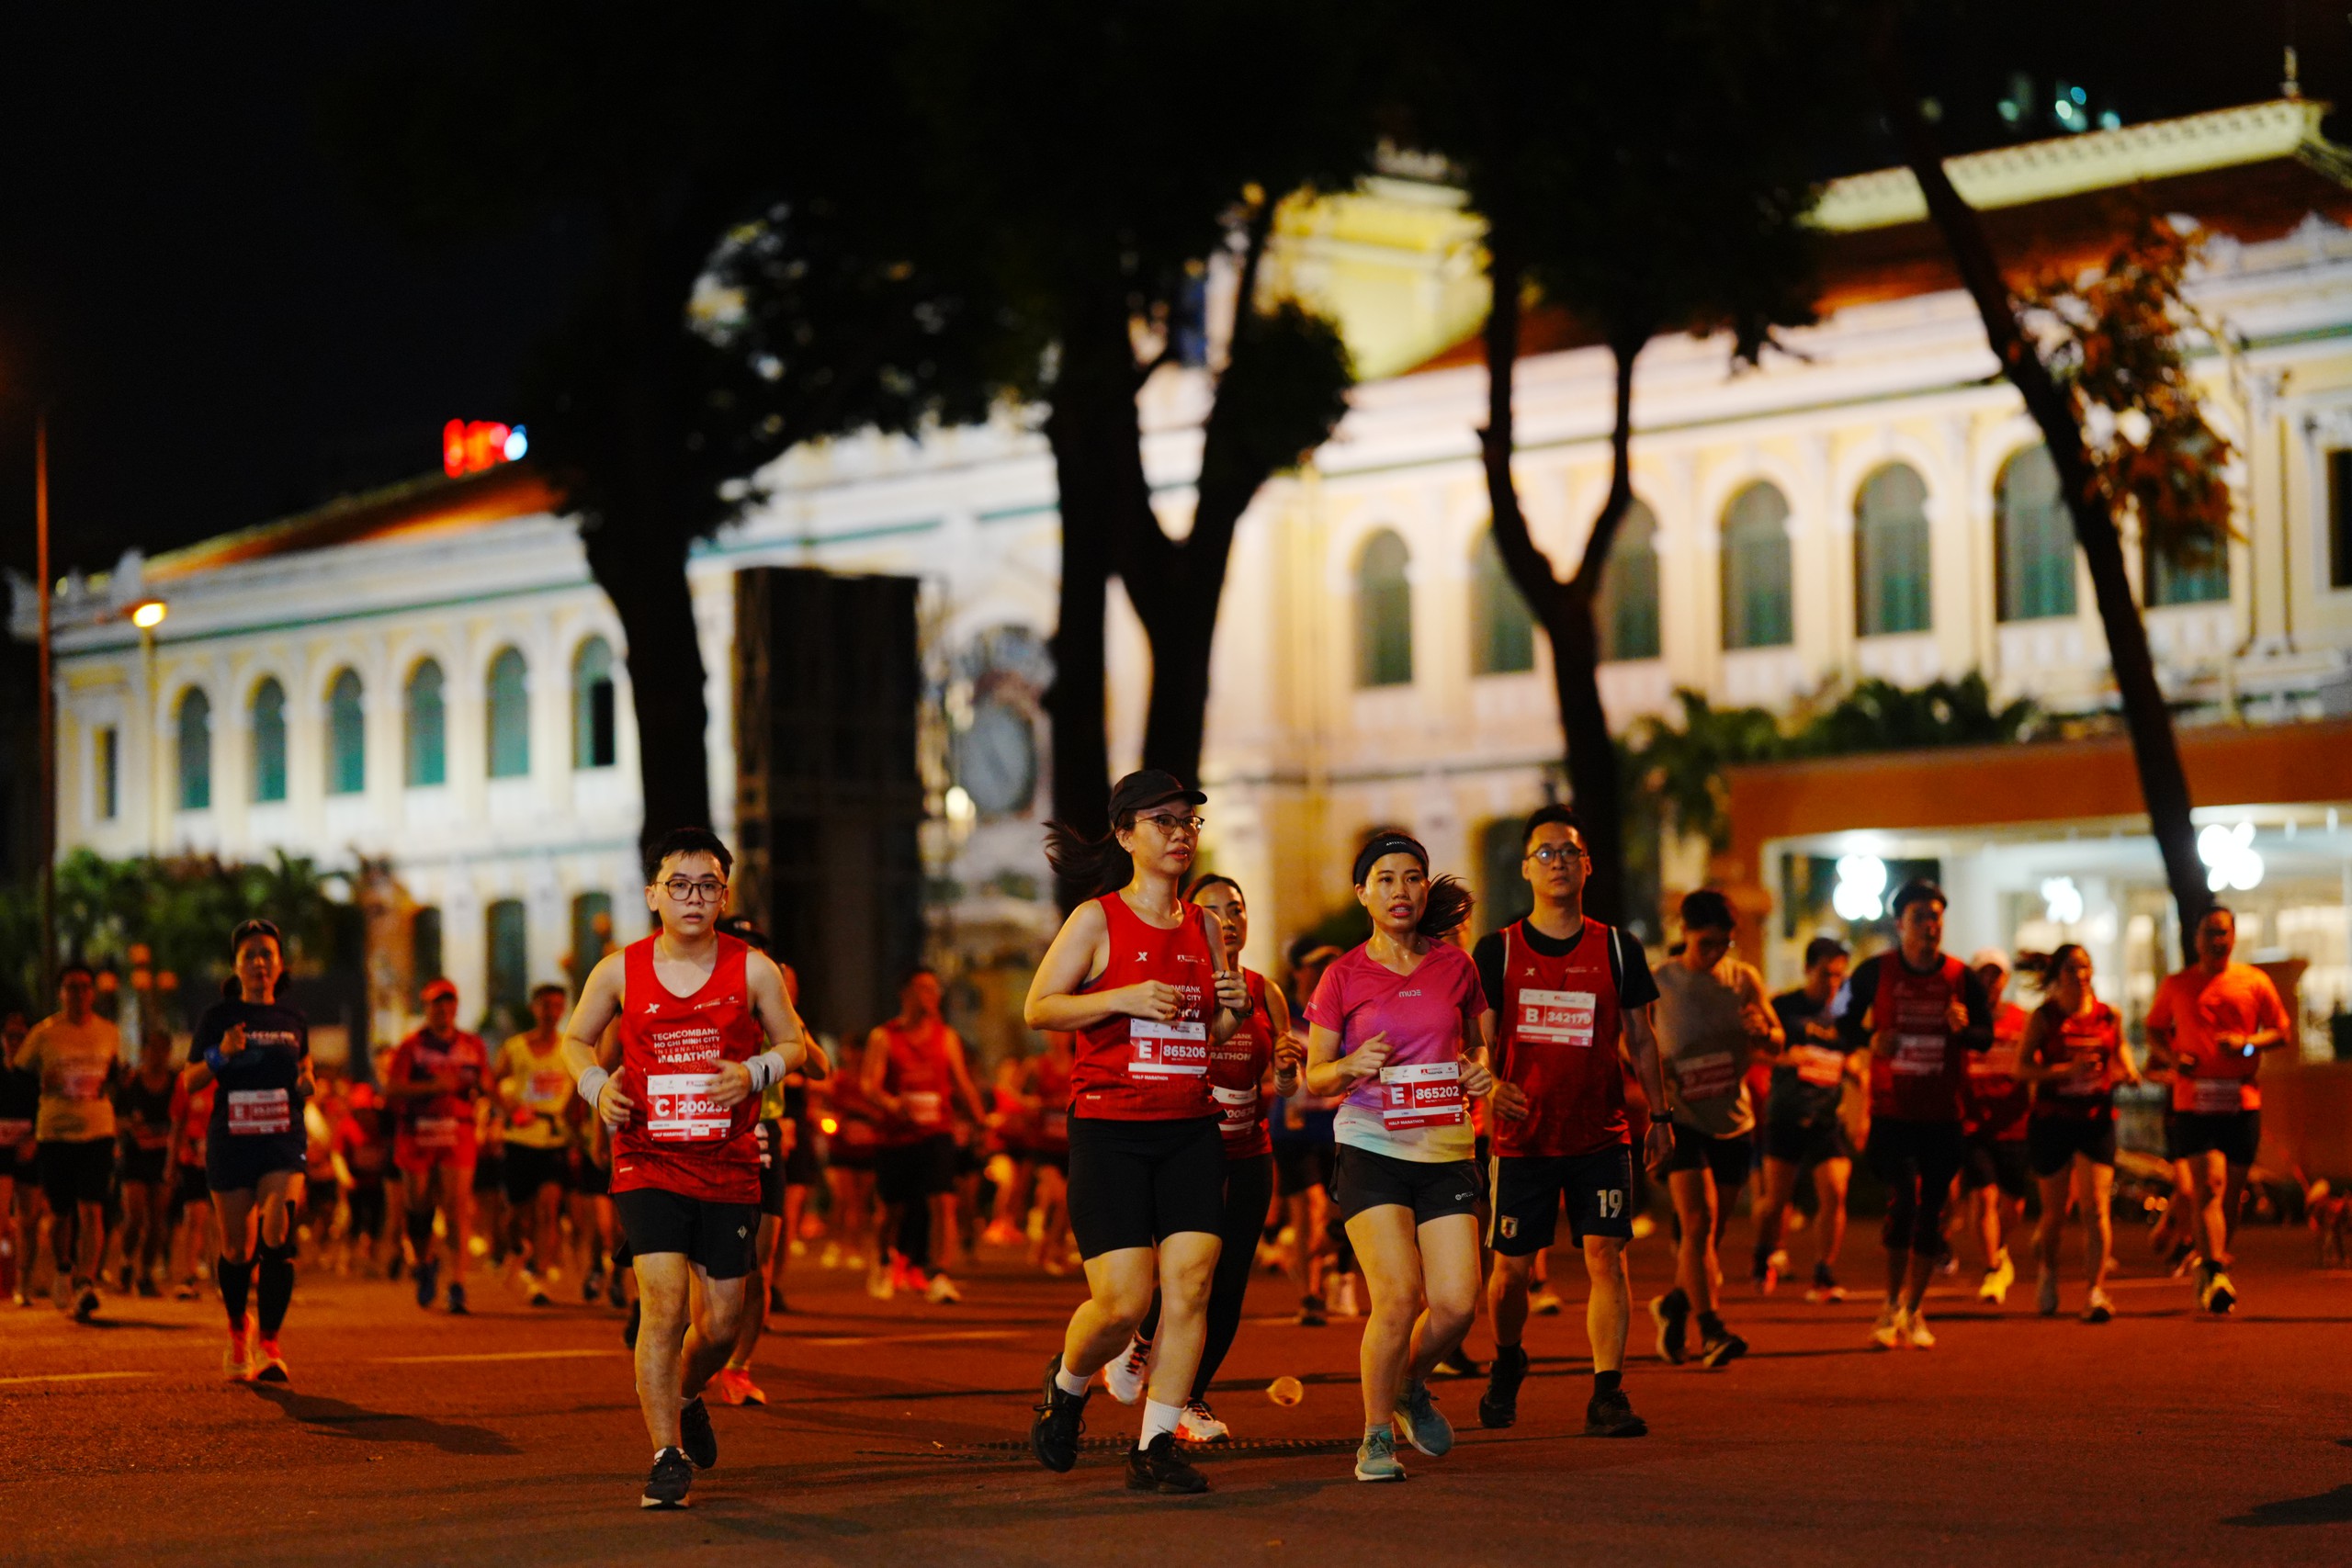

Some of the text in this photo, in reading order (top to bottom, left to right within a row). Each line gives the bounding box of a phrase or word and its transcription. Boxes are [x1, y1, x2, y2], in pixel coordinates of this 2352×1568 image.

[1526, 1008, 1591, 1024] B 342179
[652, 1029, 719, 1041] TECHCOMBANK
[658, 1050, 720, 1064] MARATHON
[1139, 1041, 1205, 1058] E 865206
[1391, 1086, 1459, 1104] E 865202
[655, 1099, 670, 1117] C
[1597, 1190, 1623, 1218] 19
